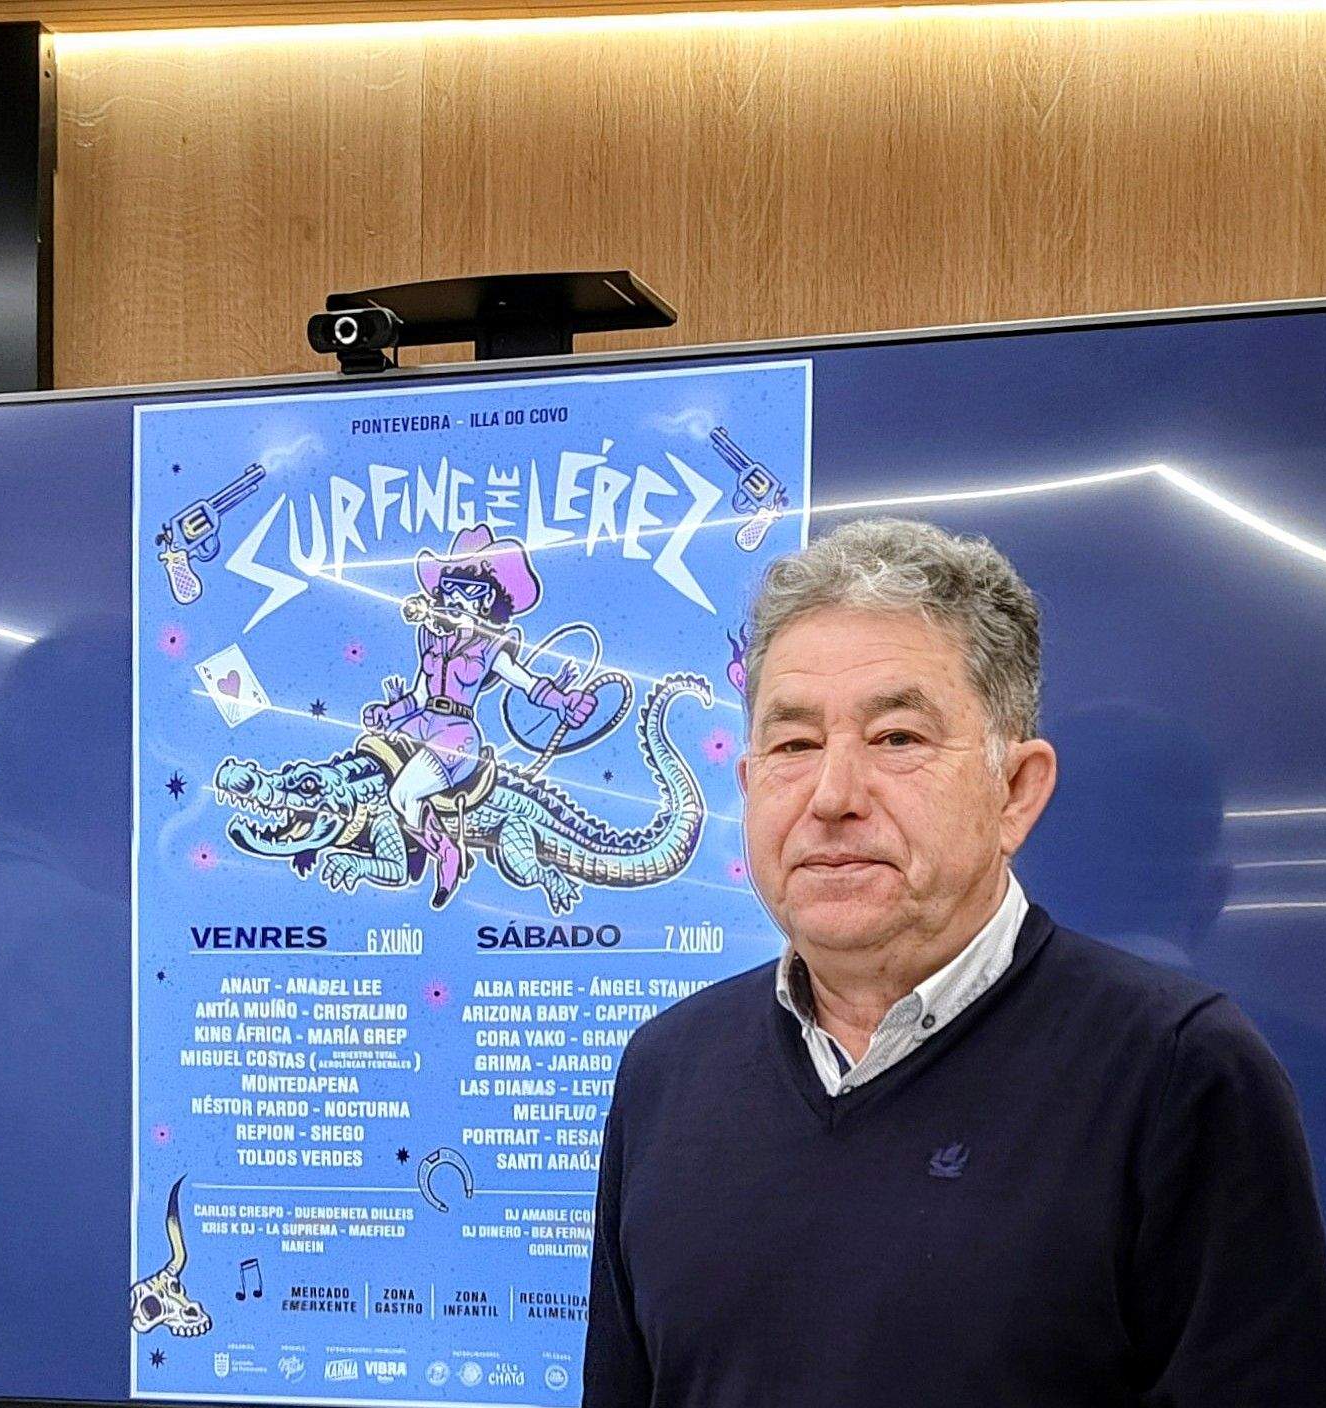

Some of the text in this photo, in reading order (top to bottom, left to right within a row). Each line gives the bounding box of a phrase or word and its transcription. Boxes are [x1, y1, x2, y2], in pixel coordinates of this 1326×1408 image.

[352, 414, 450, 435] PONTEVEDRA
[470, 412, 499, 427] ILLA
[505, 410, 523, 426] DO
[530, 407, 568, 423] COVO
[225, 438, 724, 633] SURFING THE LÉREZ
[191, 923, 423, 953] VENRES 6 XUÑO
[477, 920, 723, 953] SÁBADO 7 XUÑO
[221, 978, 270, 994] ANAUT
[286, 978, 349, 996] ANABEL
[354, 979, 382, 996] LEE
[474, 980, 514, 998] ALBA
[519, 980, 573, 997] RECHE
[590, 976, 644, 997] ÁNGEL
[195, 999, 239, 1020] ANTÍA
[314, 1003, 407, 1021] CRISTALINO
[462, 1005, 532, 1022] ARIZONA
[537, 1005, 579, 1022] BABY
[195, 1026, 232, 1042] KING
[236, 1023, 292, 1044] ÁFRICA
[308, 1025, 360, 1044] MARÍA
[364, 1029, 407, 1045] GREP
[476, 1030, 520, 1047] CORA
[525, 1030, 565, 1047] YAKO
[181, 1050, 305, 1069] MIGUEL COSTAS
[475, 1055, 532, 1072] GRIMA
[548, 1055, 612, 1072] JARABO
[242, 1074, 359, 1093] MONTEDAPENA
[460, 1079, 489, 1096] LAS
[192, 1095, 253, 1116] NÉSTOR
[257, 1101, 308, 1117] PARDO
[325, 1101, 410, 1118] NOCTURNA
[513, 1104, 597, 1121] MELIFLUO
[236, 1124, 294, 1141] REPION
[311, 1125, 364, 1141] SHEGO
[462, 1129, 540, 1145] PORTRAIT
[237, 1149, 363, 1167] TOLDOS VERDES
[496, 1153, 542, 1170] SANTI
[194, 1204, 236, 1218] CARLOS
[239, 1206, 283, 1218] CRESPO
[505, 1209, 519, 1221] DJ
[522, 1209, 568, 1221] AMABLE
[202, 1222, 228, 1234] KRIS
[231, 1223, 239, 1234] K
[241, 1223, 254, 1235] DJ
[266, 1223, 280, 1235] LA
[282, 1223, 338, 1236] SUPREMA
[349, 1225, 405, 1238] MAEFIELD
[462, 1225, 476, 1238] DJ
[479, 1226, 521, 1238] DINERO
[291, 1287, 350, 1299] MERCADO
[383, 1288, 415, 1300] ZONA
[455, 1291, 487, 1303] ZONA
[282, 1300, 357, 1313] EMERXENTE
[375, 1303, 423, 1314] GASTRO
[443, 1305, 499, 1317] INFANTIL
[325, 1360, 358, 1379] KARMA
[364, 1360, 408, 1377] VIBRA
